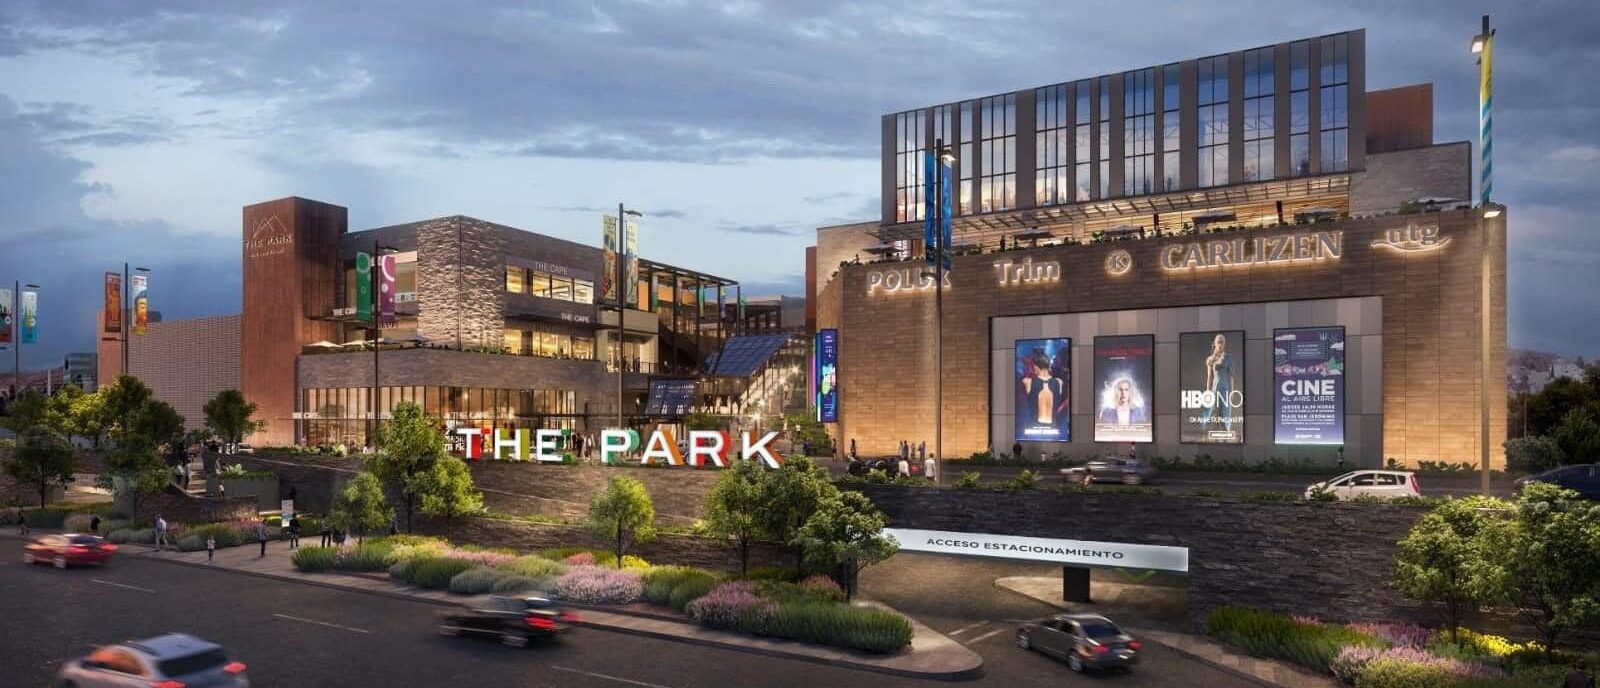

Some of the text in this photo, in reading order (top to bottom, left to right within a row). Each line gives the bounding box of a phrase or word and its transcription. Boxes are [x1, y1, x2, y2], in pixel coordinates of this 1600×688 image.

[1386, 222, 1440, 247] utg
[1160, 231, 1344, 271] CARLIZEN
[535, 260, 547, 272] THE
[993, 257, 1061, 286] Trim
[1181, 390, 1216, 408] HBO
[1281, 379, 1335, 395] CINE
[458, 427, 566, 461] THE
[601, 428, 783, 469] PARK
[926, 537, 1125, 560] ACCESO ESTACIONAMIENTO
